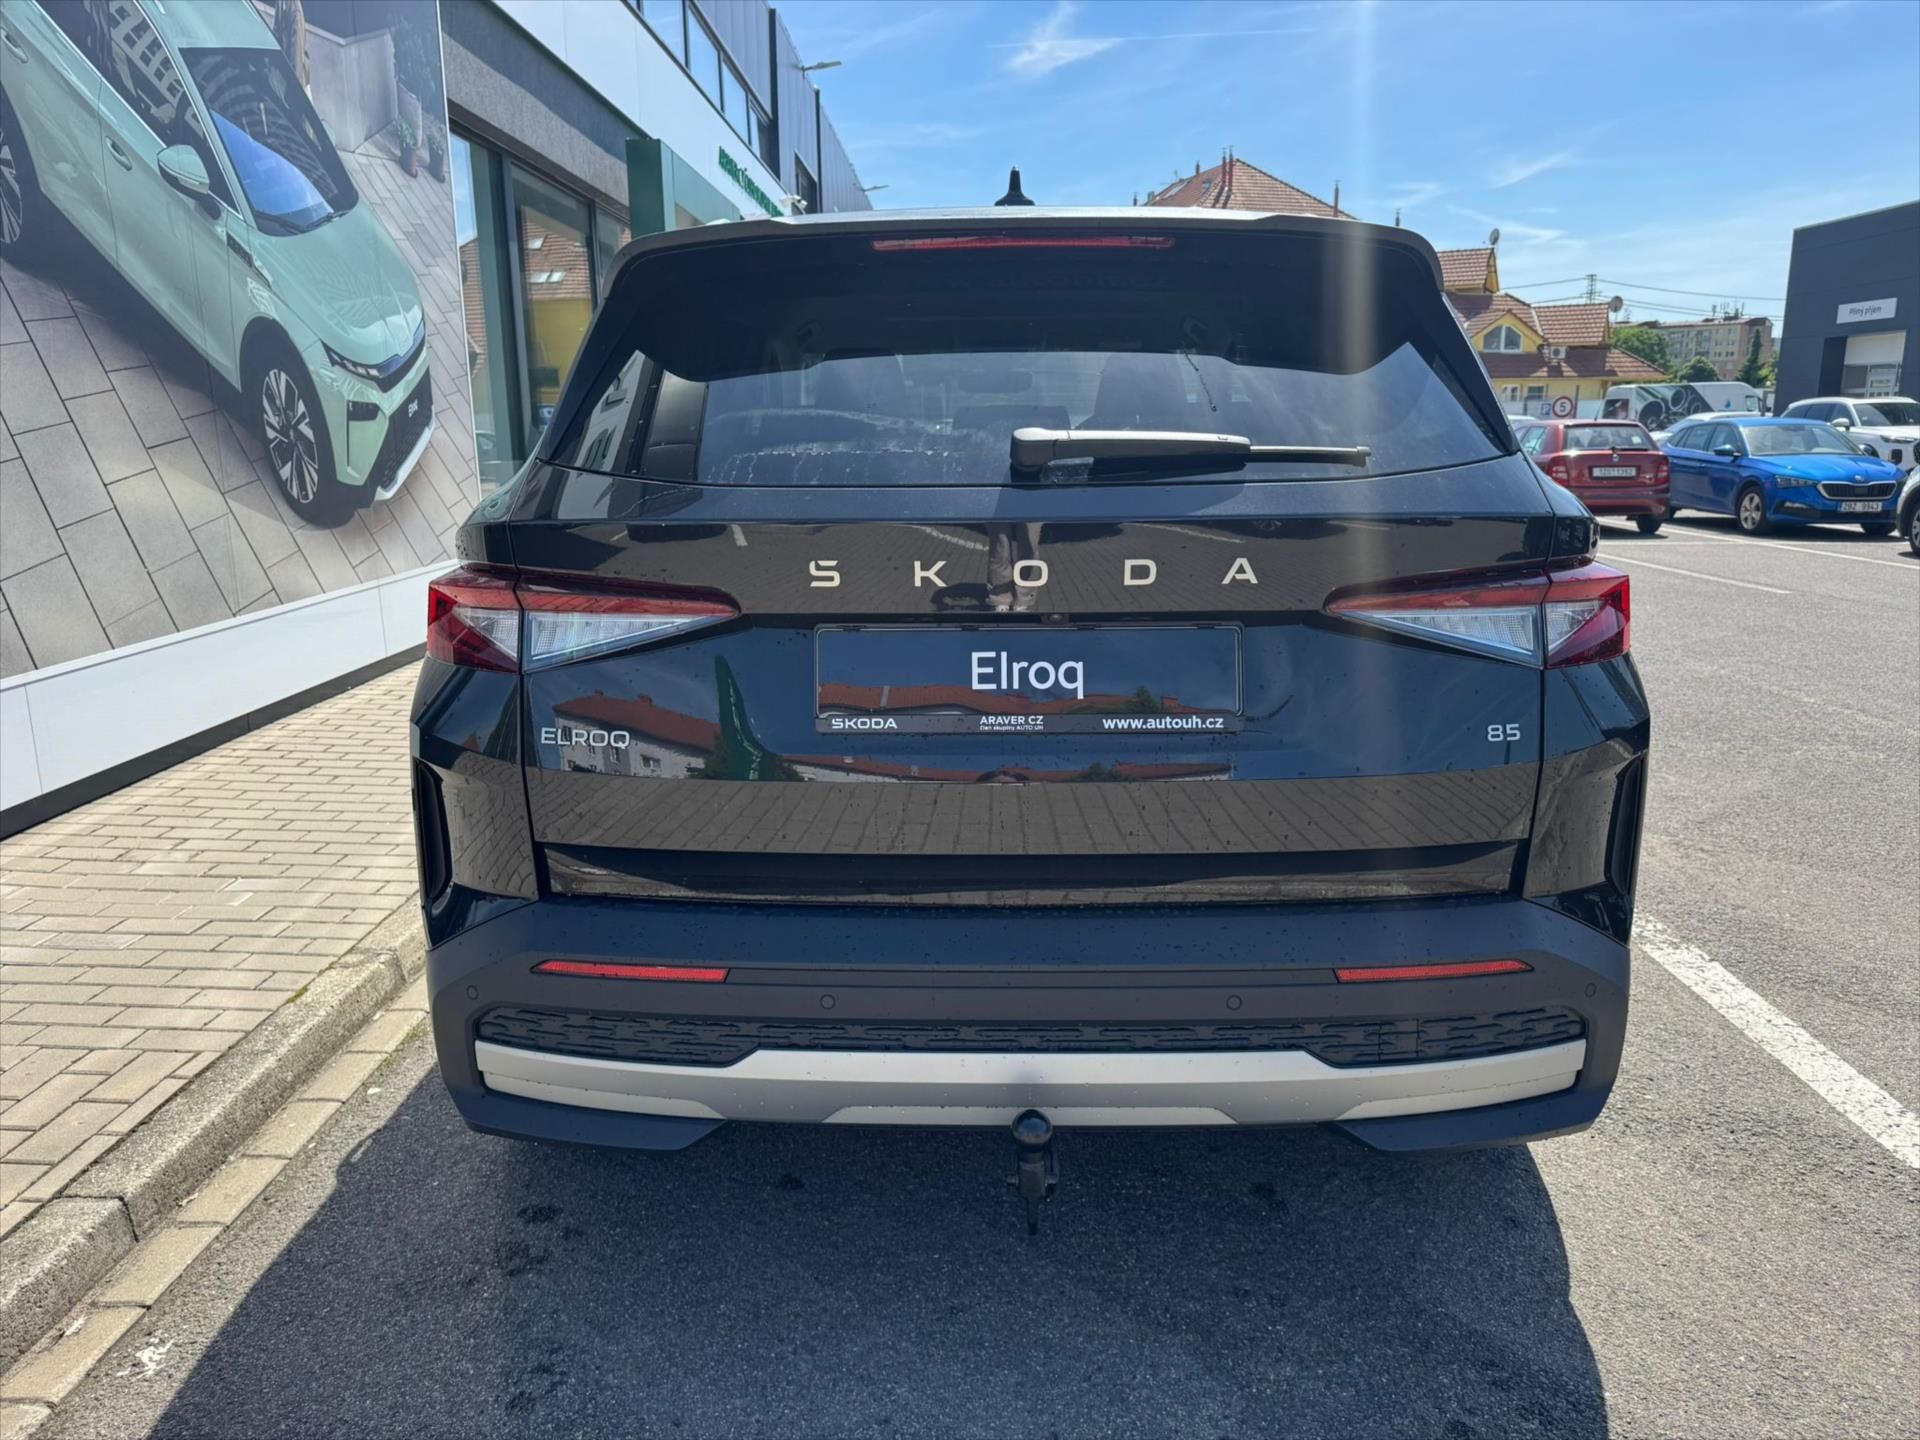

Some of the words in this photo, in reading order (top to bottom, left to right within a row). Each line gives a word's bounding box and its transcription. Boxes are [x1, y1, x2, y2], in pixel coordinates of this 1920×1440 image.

[1559, 401, 1567, 413] 5
[971, 651, 1084, 700] Elroq
[831, 718, 898, 729] SKODA
[980, 715, 1025, 725] ARAVER
[1028, 715, 1044, 725] CZ
[1102, 715, 1224, 729] www.autouh.cz
[541, 727, 630, 750] ELROQ
[1487, 723, 1521, 741] 85
